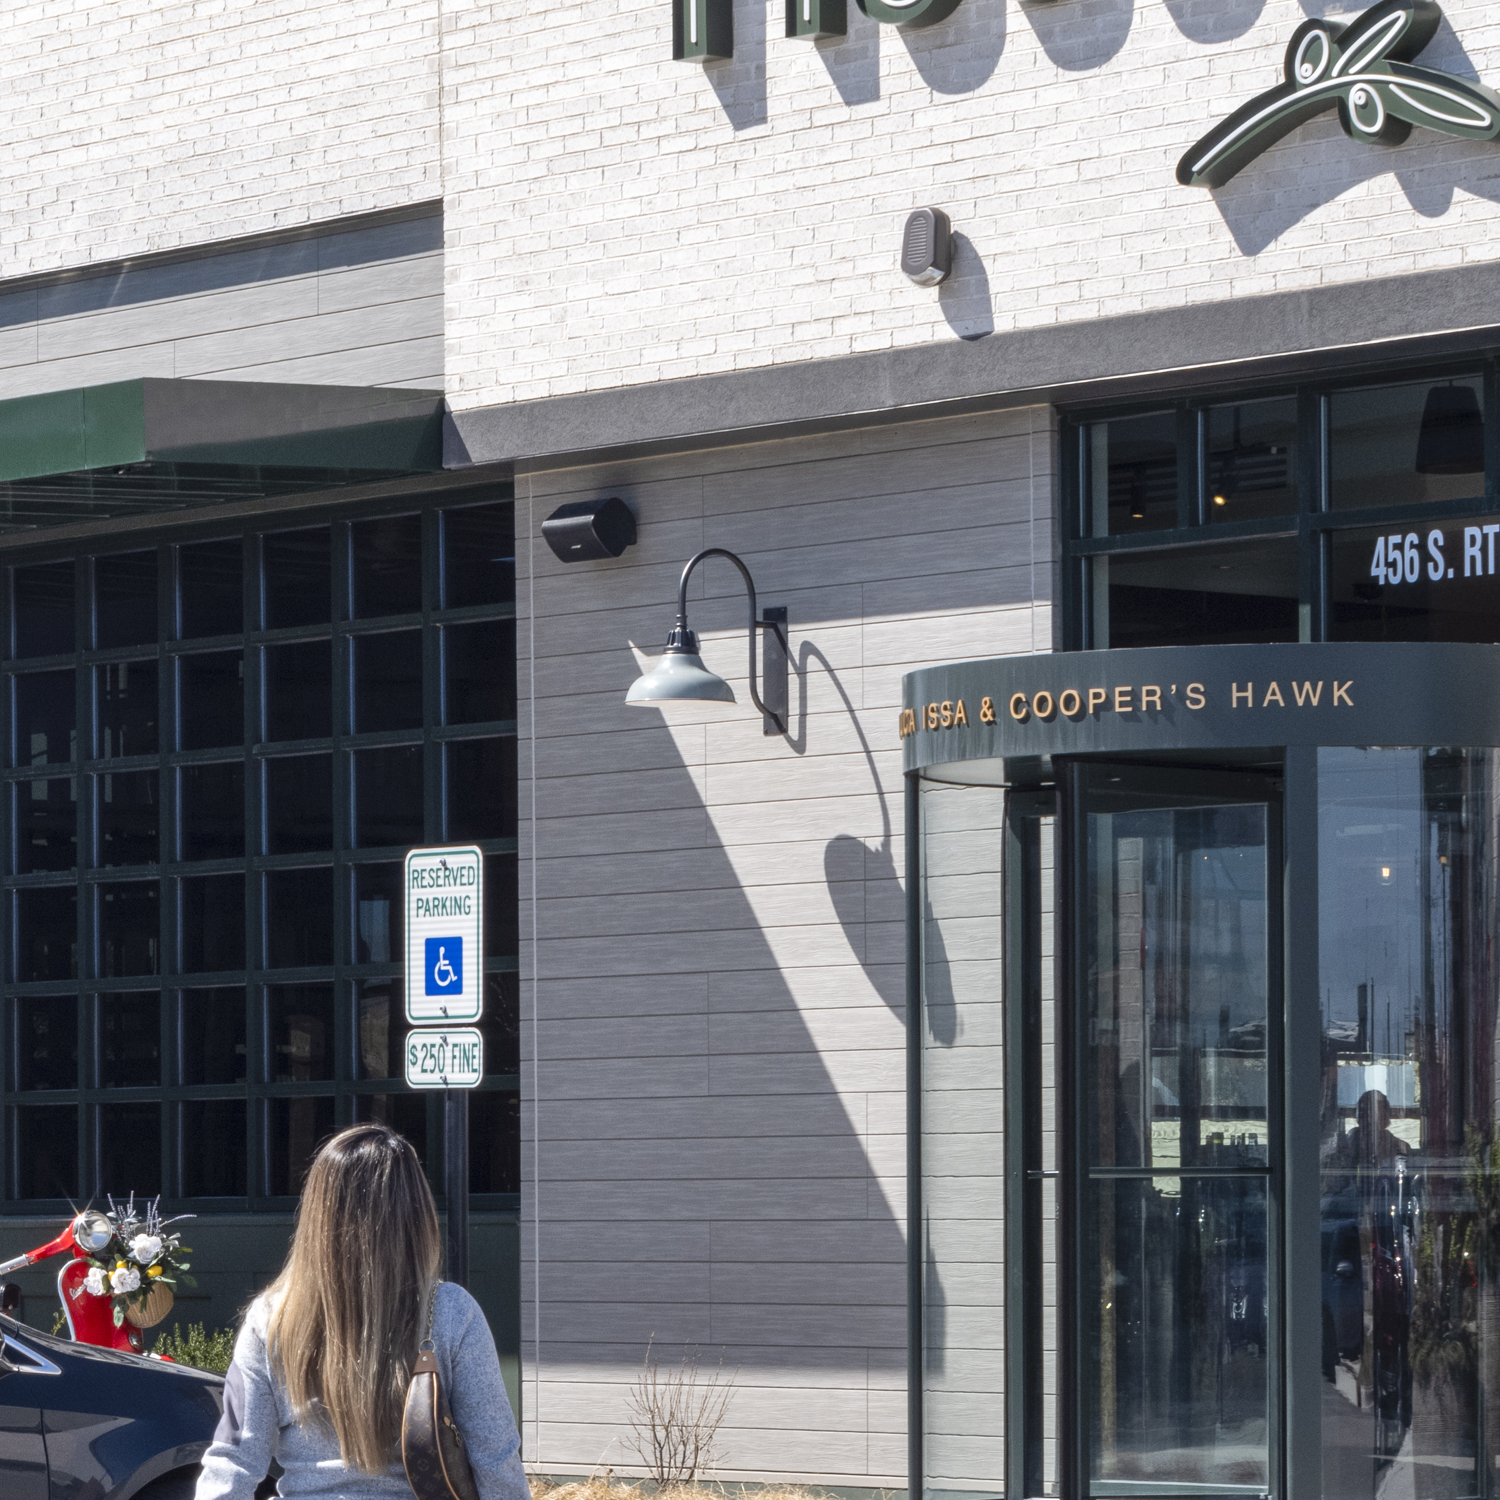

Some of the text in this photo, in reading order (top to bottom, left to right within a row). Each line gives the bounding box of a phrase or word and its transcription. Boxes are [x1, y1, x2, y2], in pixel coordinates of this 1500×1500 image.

[1370, 531, 1420, 585] 456
[1427, 529, 1454, 581] S.
[922, 699, 967, 730] ISSA
[979, 696, 995, 723] &
[1009, 681, 1207, 720] COOPER'S
[1231, 680, 1355, 708] HAWK
[412, 866, 476, 889] RESERVED
[416, 895, 472, 918] PARKING
[451, 1043, 478, 1074] FINE
